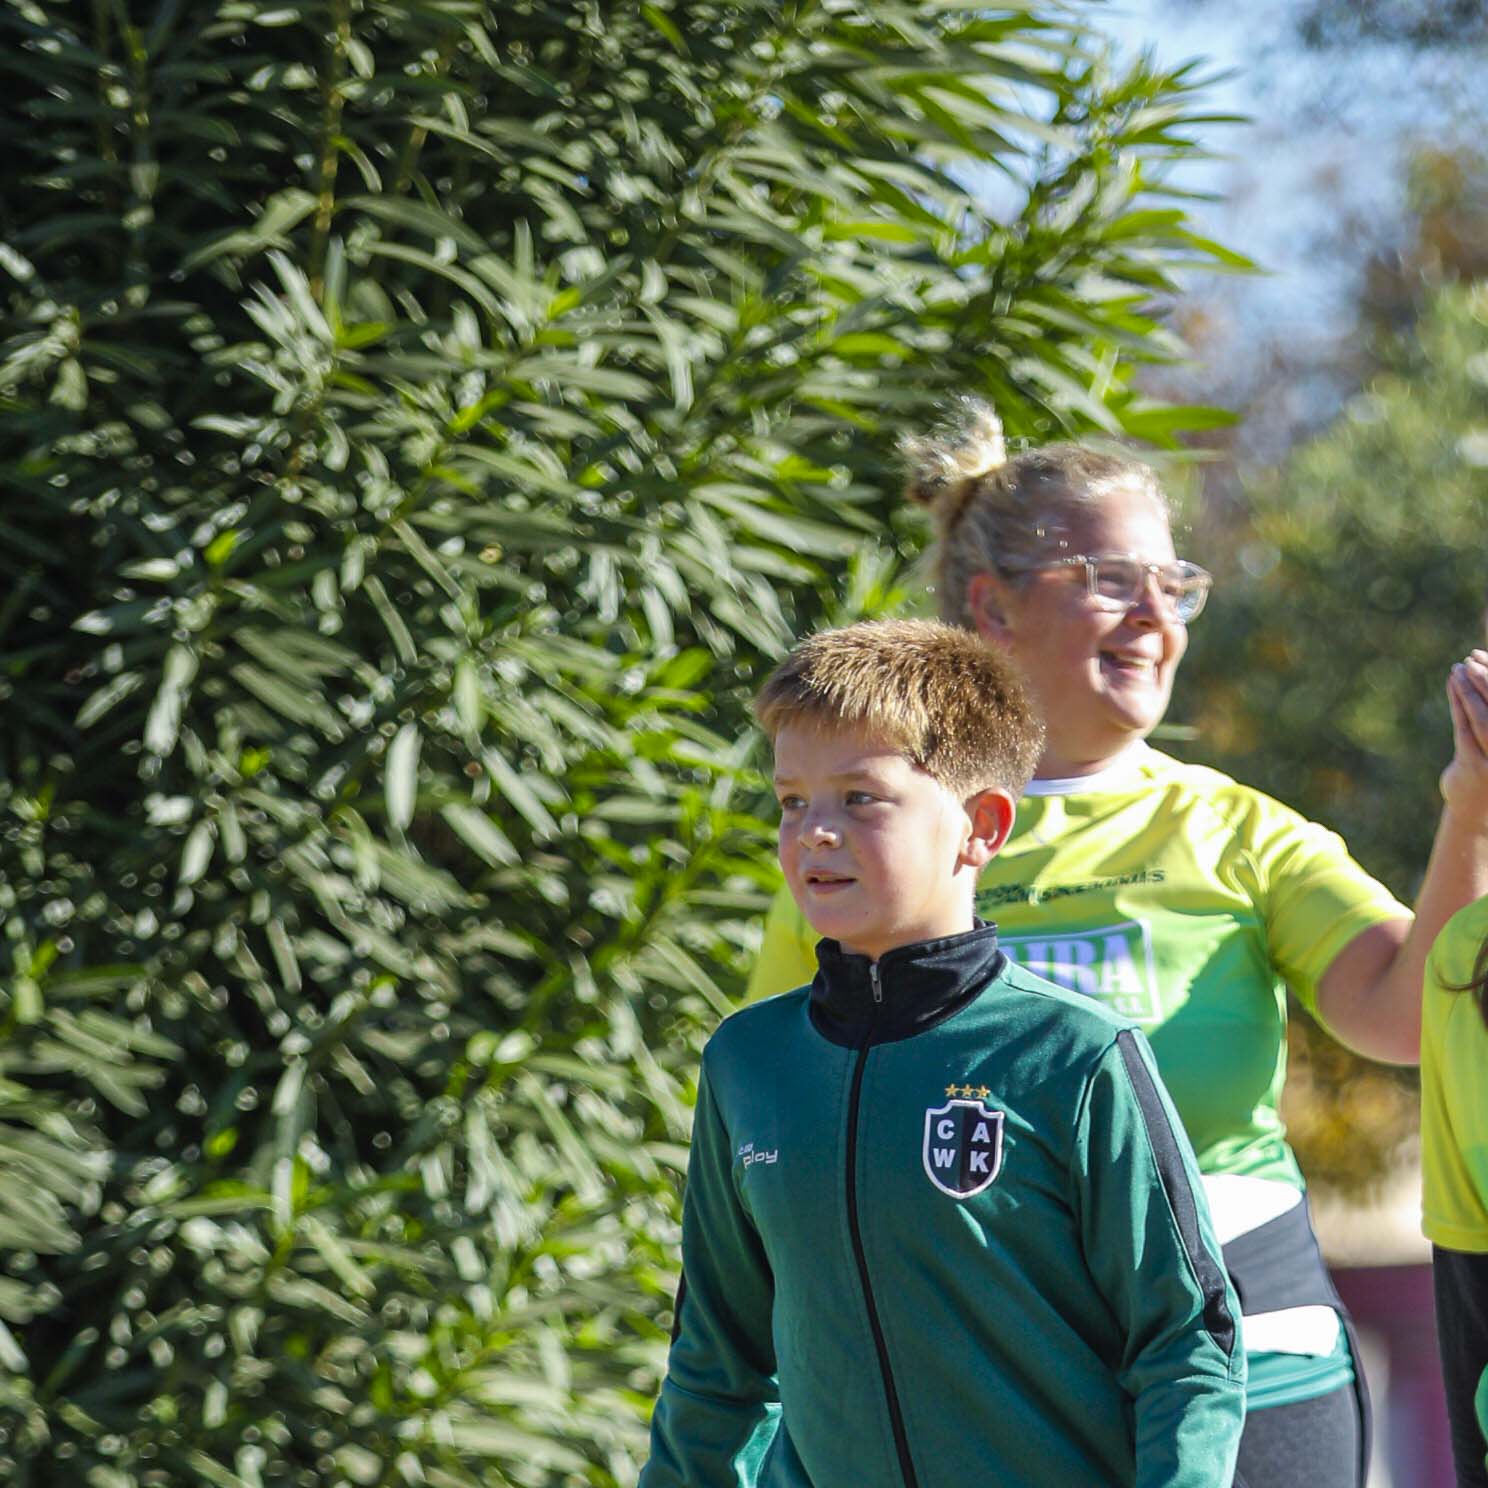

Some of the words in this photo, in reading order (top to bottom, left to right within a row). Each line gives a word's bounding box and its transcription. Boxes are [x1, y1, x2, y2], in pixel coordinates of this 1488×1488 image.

[937, 1119, 955, 1140] C
[971, 1122, 991, 1143] A
[933, 1148, 956, 1168] W
[969, 1151, 990, 1173] K
